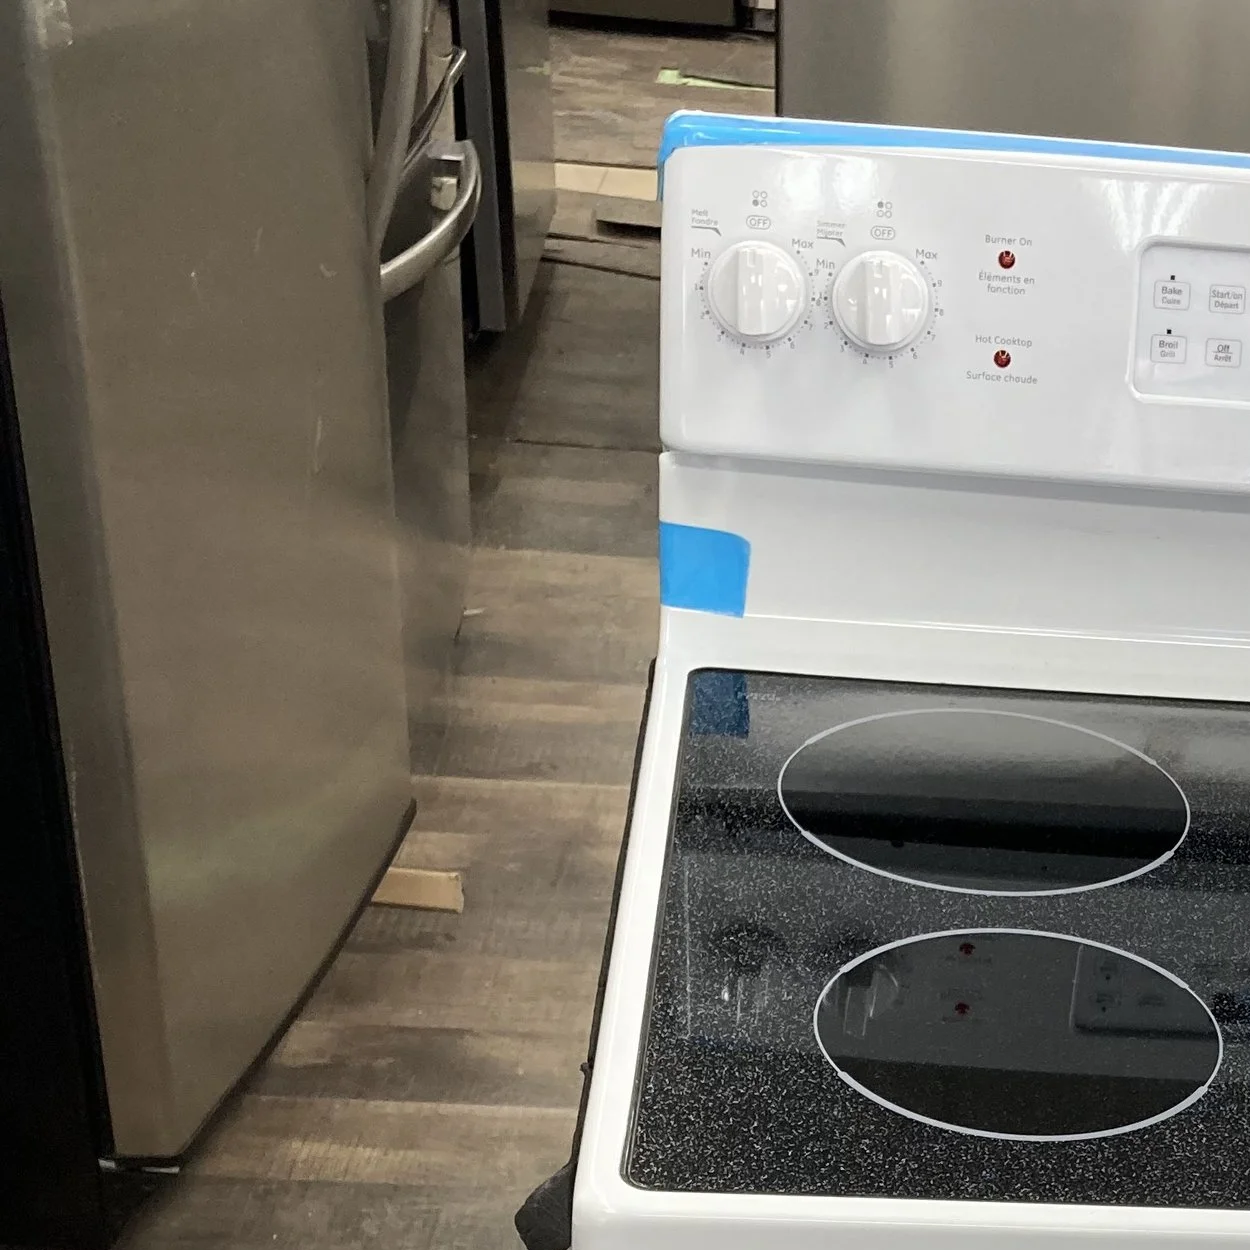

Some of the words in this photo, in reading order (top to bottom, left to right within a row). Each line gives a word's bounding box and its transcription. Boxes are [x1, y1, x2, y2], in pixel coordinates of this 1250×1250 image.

[749, 218, 768, 227] OFF
[874, 228, 893, 237] OFF
[792, 239, 814, 249] Max
[985, 234, 1016, 245] Burner
[1019, 237, 1032, 247] On
[691, 248, 711, 259] Min
[915, 248, 938, 260] Max
[816, 259, 835, 269] Min
[1023, 276, 1035, 285] en
[987, 285, 1025, 295] fonction
[1161, 286, 1183, 296] Bake
[975, 334, 992, 345] Hot
[994, 336, 1032, 348] Cooktop
[1158, 340, 1179, 349] Broil
[1217, 344, 1231, 352] Off
[966, 371, 1001, 382] Surface
[1003, 373, 1038, 385] chaude
